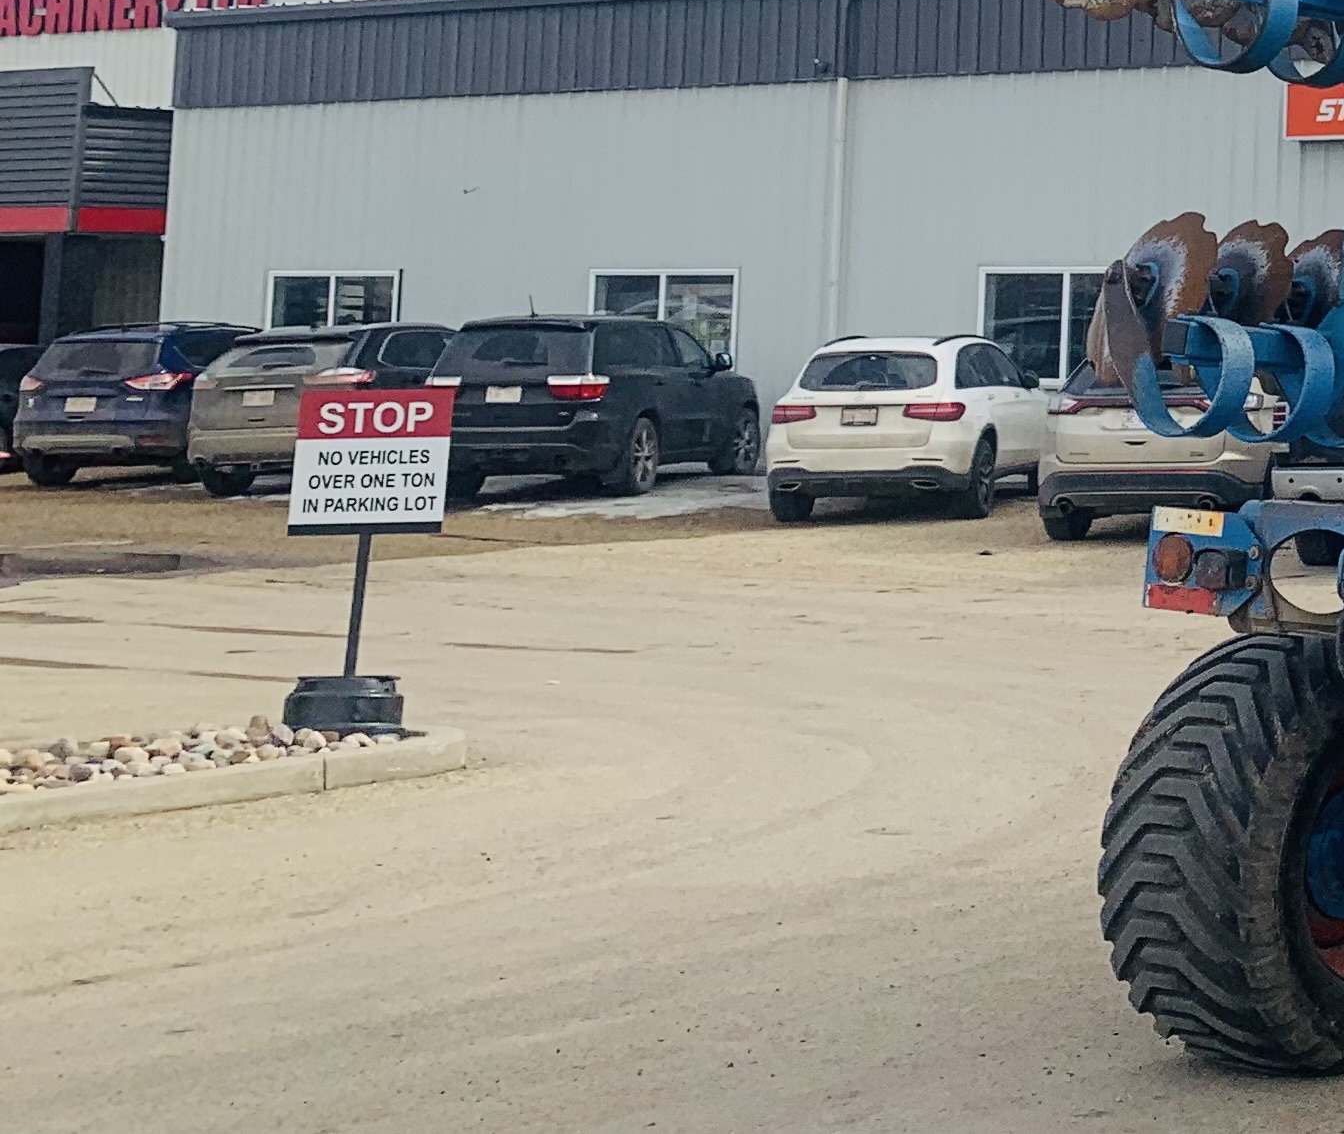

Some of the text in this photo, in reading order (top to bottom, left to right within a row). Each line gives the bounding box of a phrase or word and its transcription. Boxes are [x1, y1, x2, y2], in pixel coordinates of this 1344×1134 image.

[318, 401, 434, 435] STOP
[318, 449, 430, 466] NO VEHICLES
[308, 472, 436, 489] OVER ONE TON
[302, 496, 437, 513] IN PARKING LOT
